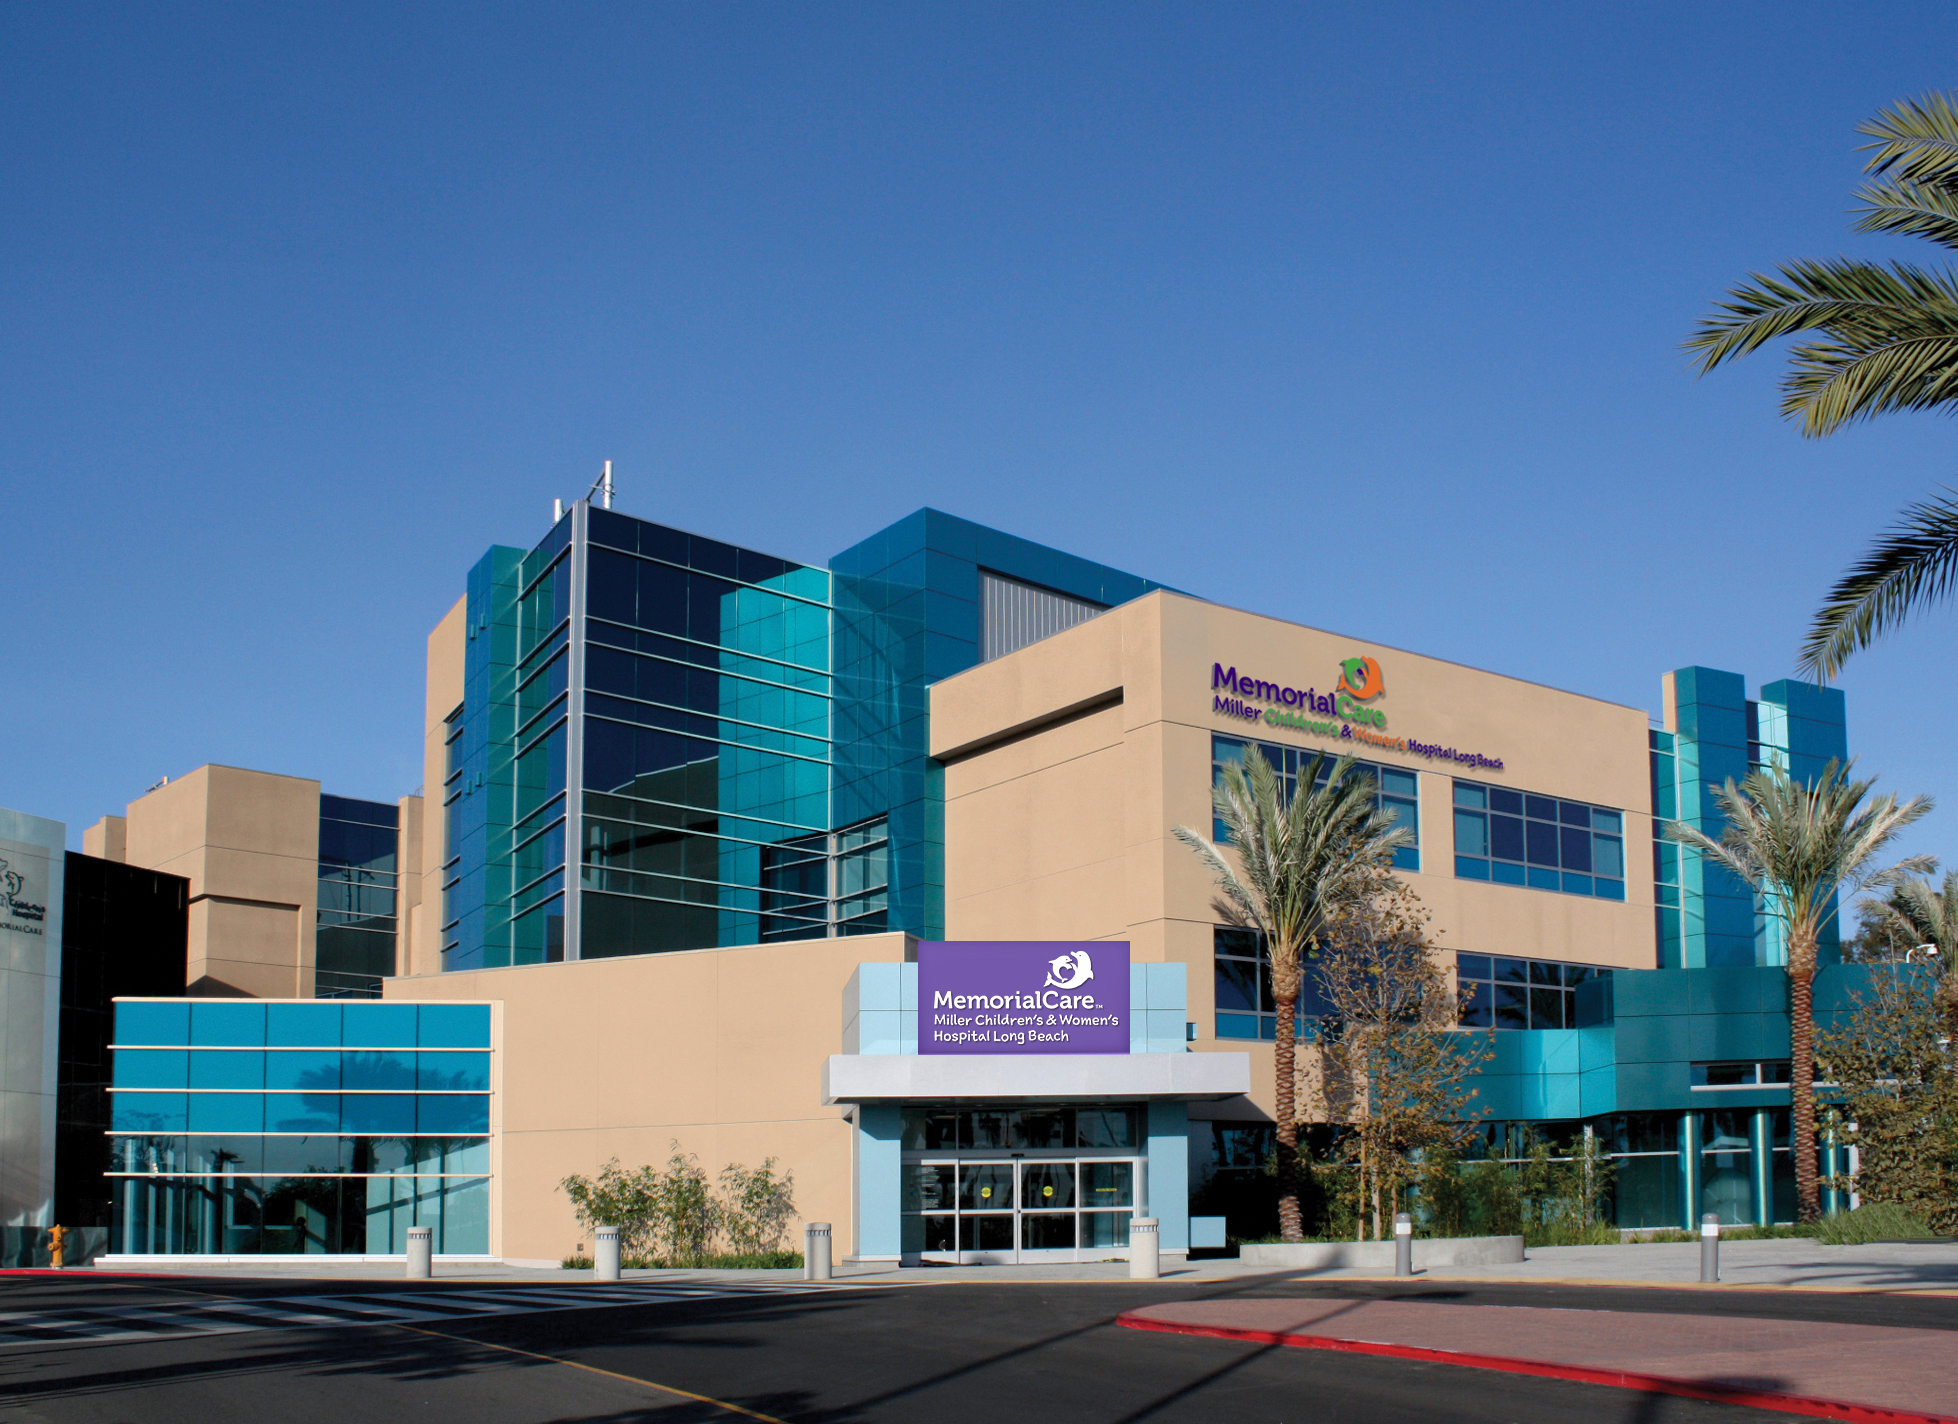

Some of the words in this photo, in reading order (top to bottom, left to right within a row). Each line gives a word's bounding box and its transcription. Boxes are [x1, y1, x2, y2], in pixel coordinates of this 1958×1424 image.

[1214, 662, 1386, 726] MemorialCare
[1214, 695, 1262, 720] Miller
[1265, 707, 1339, 736] Children's
[1341, 724, 1352, 738] &
[1353, 725, 1406, 750] Women's
[1408, 738, 1452, 759] Hospital
[1453, 748, 1476, 767] Long
[933, 990, 1095, 1010] MemorialCare
[934, 1014, 972, 1026] Miller
[975, 1014, 1043, 1026] Children's
[1046, 1014, 1057, 1026] &
[1059, 1014, 1119, 1026] Women's
[934, 1030, 990, 1044] Hospital
[993, 1030, 1025, 1045] Long
[1028, 1030, 1069, 1042] Beach
